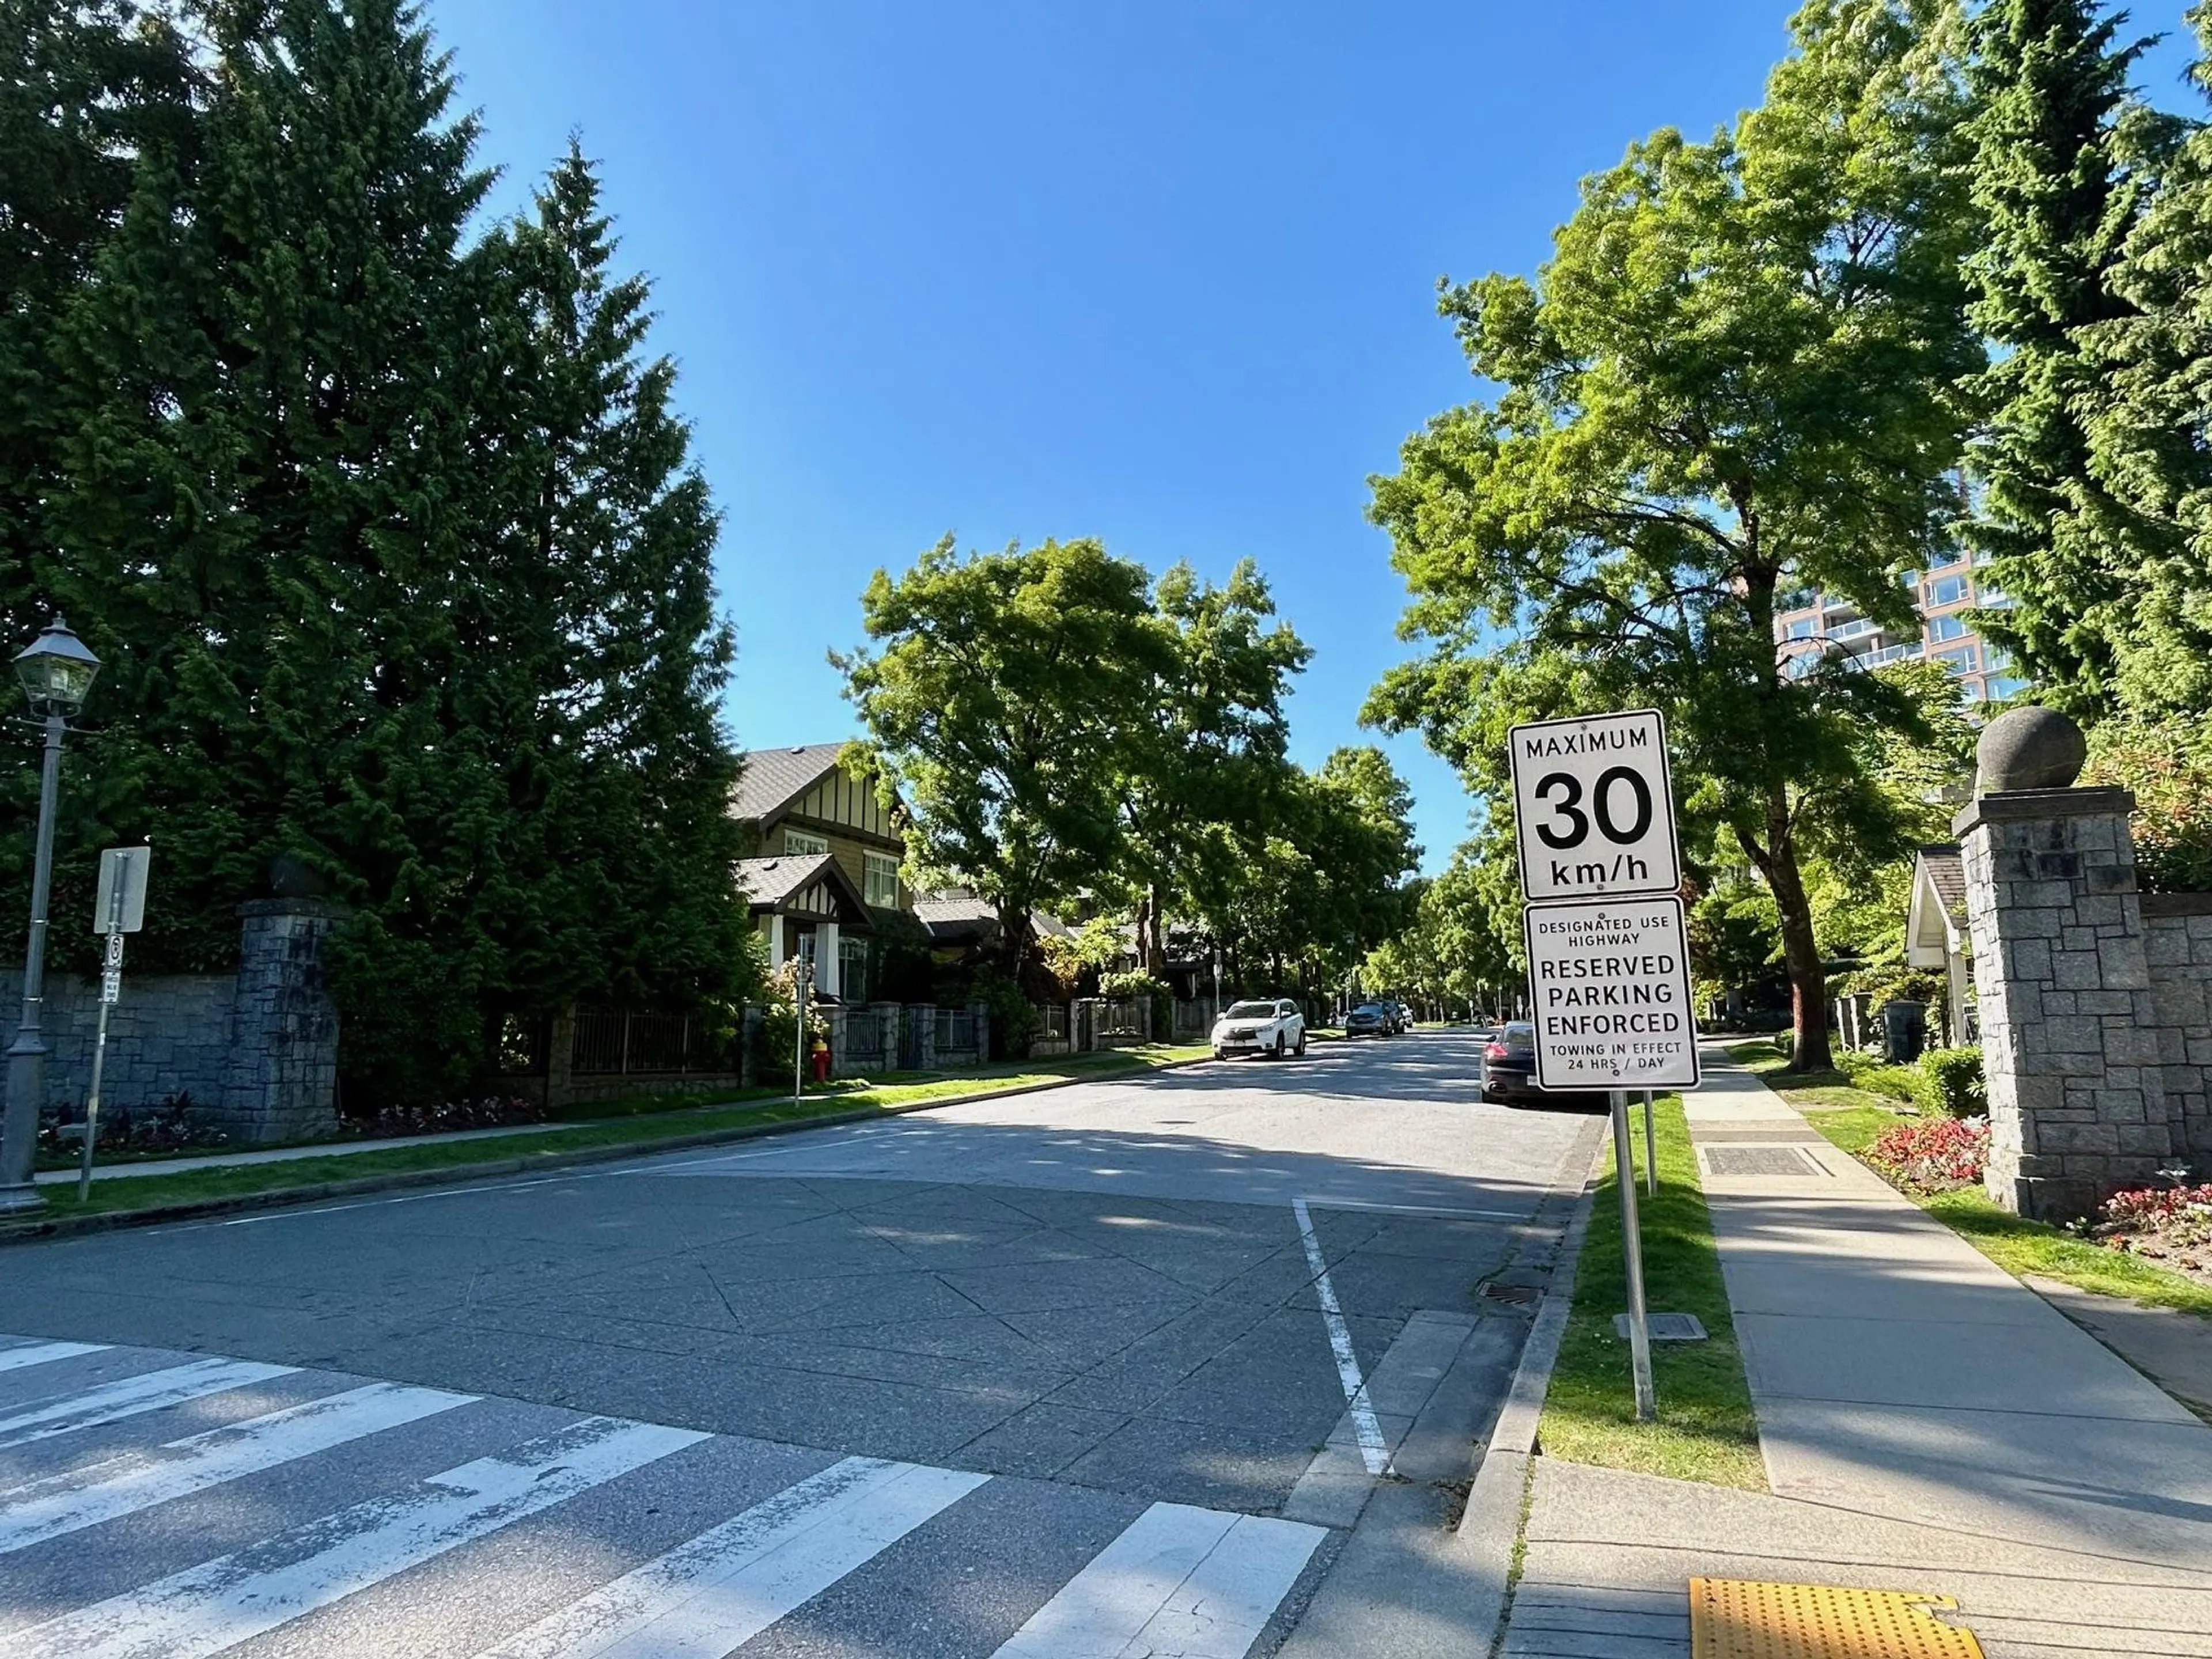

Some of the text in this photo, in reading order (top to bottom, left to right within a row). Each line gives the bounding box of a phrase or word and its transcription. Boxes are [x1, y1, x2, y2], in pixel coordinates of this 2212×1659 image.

[1526, 728, 1647, 759] MAXIMUM
[1535, 766, 1653, 850] 30
[1551, 854, 1648, 886] km/h
[1539, 916, 1669, 934] DESIGNATED USE
[1569, 933, 1640, 947] HIGHWAY
[1541, 955, 1675, 979] RESERVED
[1548, 983, 1672, 1007] PARKING
[1547, 1012, 1680, 1036] ENFORCED
[1550, 1042, 1682, 1056] TOWING IN EFFECT
[1567, 1059, 1584, 1070] 24
[1590, 1058, 1618, 1070] HRS
[1638, 1057, 1665, 1069] DAY
